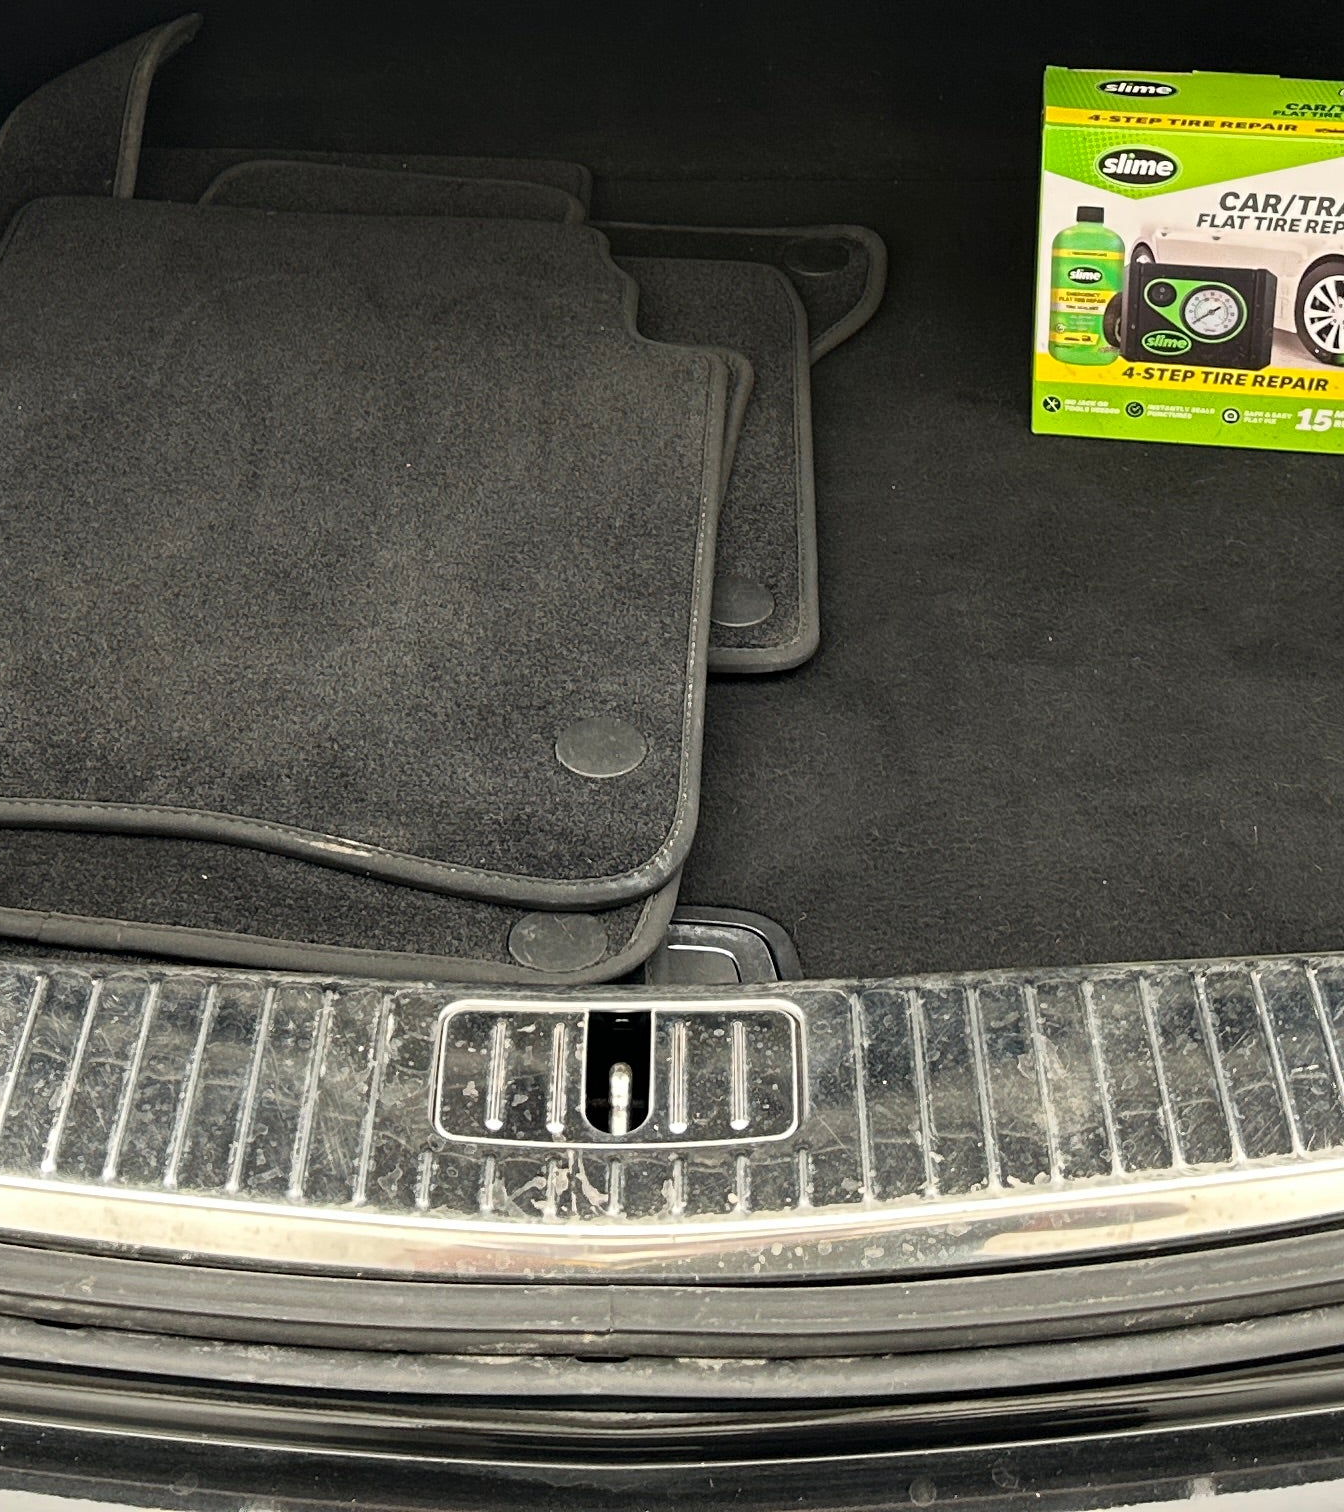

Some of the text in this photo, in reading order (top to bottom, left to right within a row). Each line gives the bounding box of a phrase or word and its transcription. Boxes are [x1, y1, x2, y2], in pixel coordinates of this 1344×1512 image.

[1104, 82, 1172, 94] slime
[1088, 114, 1299, 131] 4-STEP TIRE REPAIR
[1102, 152, 1174, 176] slime
[1196, 213, 1250, 229] FLAT
[1254, 216, 1302, 232] TIRE
[1069, 268, 1101, 280] slime
[1146, 335, 1187, 349] slime
[1122, 367, 1329, 392] 4-STEP TIRE REPAIR
[1295, 408, 1334, 432] 15
